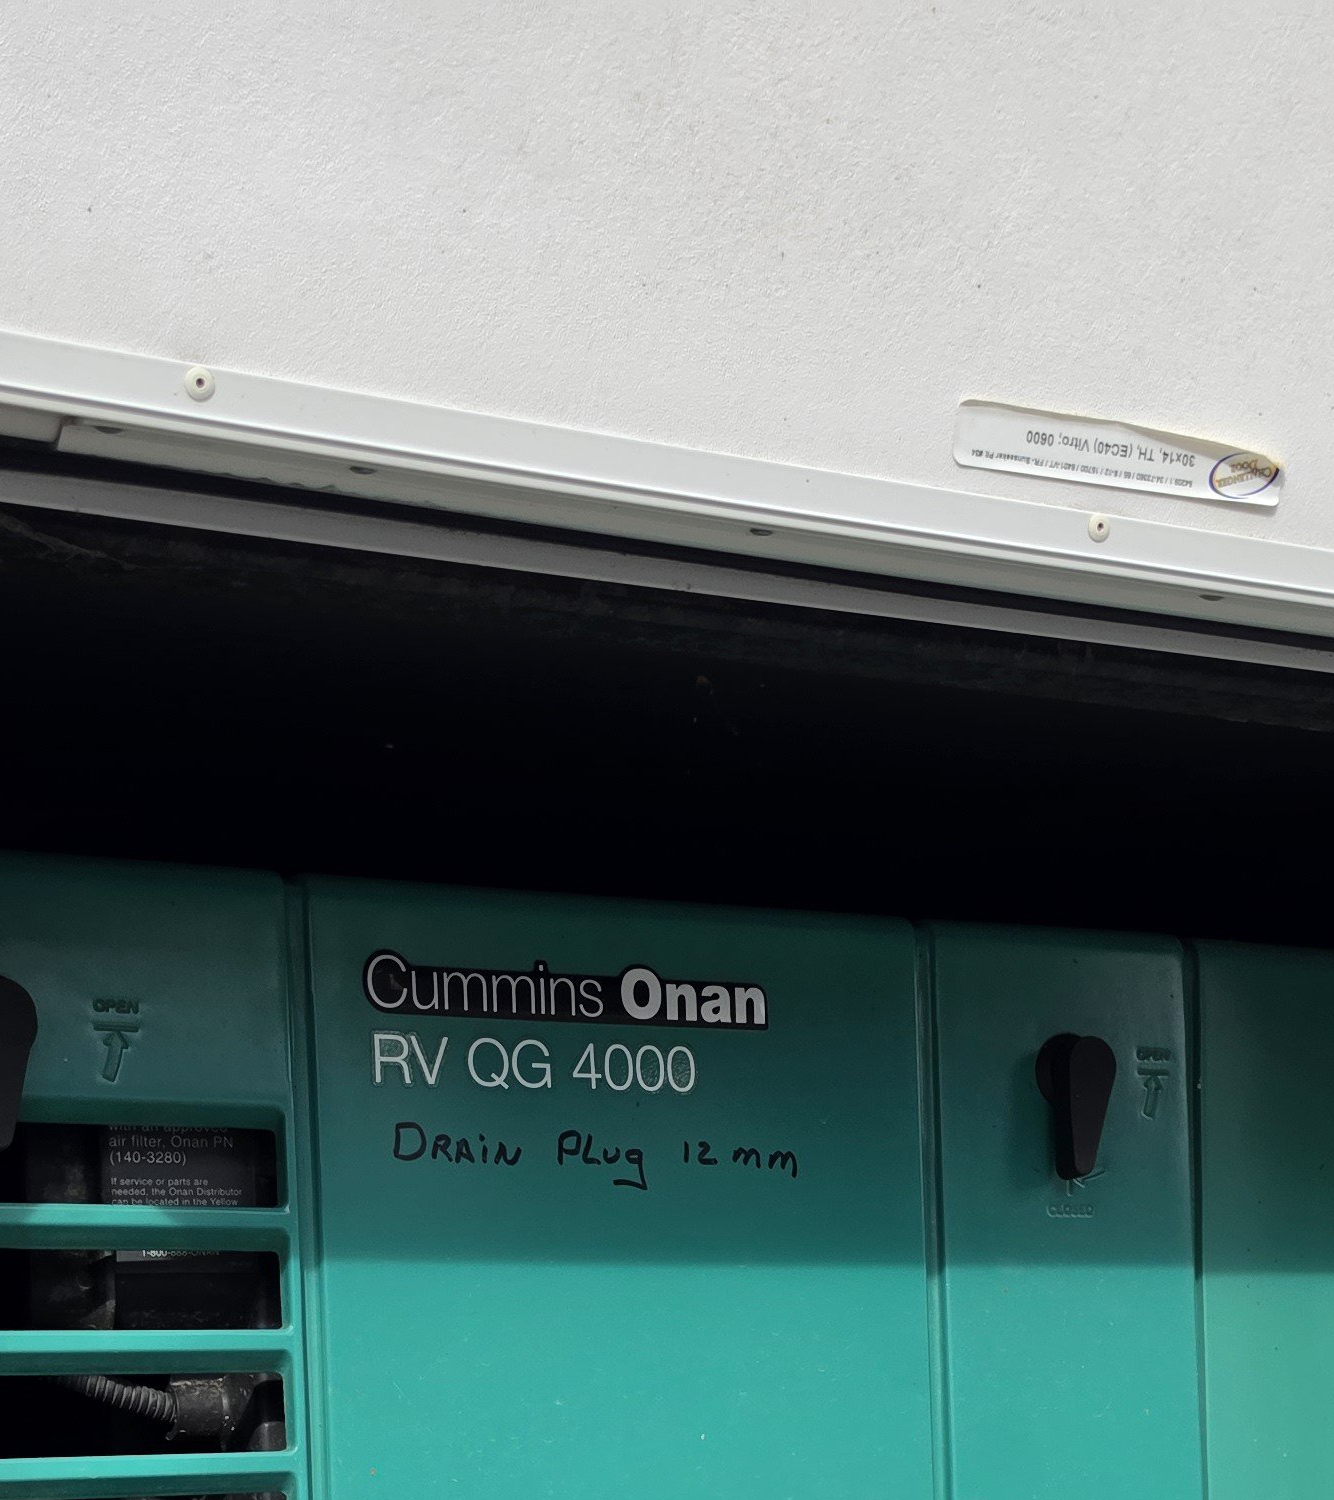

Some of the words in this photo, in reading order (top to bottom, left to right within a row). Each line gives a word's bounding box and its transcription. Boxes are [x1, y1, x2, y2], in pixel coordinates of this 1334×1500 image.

[1026, 430, 1054, 447] 0600
[1094, 438, 1133, 459] (EC40)
[1159, 448, 1195, 468] 30x14,
[367, 954, 603, 1018] Cummins
[621, 968, 766, 1025] Onan
[373, 1033, 448, 1085] RV
[468, 1037, 552, 1090] QG
[573, 1042, 697, 1092] 4000
[109, 1135, 126, 1147] air
[131, 1136, 166, 1148] filter,
[171, 1136, 208, 1147] Onan
[213, 1137, 233, 1148] PN
[110, 1151, 187, 1166] (140-3280)
[683, 1140, 718, 1166] 12
[732, 1146, 798, 1179] mm
[168, 1178, 191, 1187] parts
[111, 1188, 149, 1197] needed,
[152, 1188, 166, 1196] the
[169, 1187, 193, 1196] Onan
[197, 1187, 242, 1196] Distributor
[146, 1198, 179, 1206] located
[193, 1198, 207, 1206] the
[210, 1198, 239, 1206] Yellow
